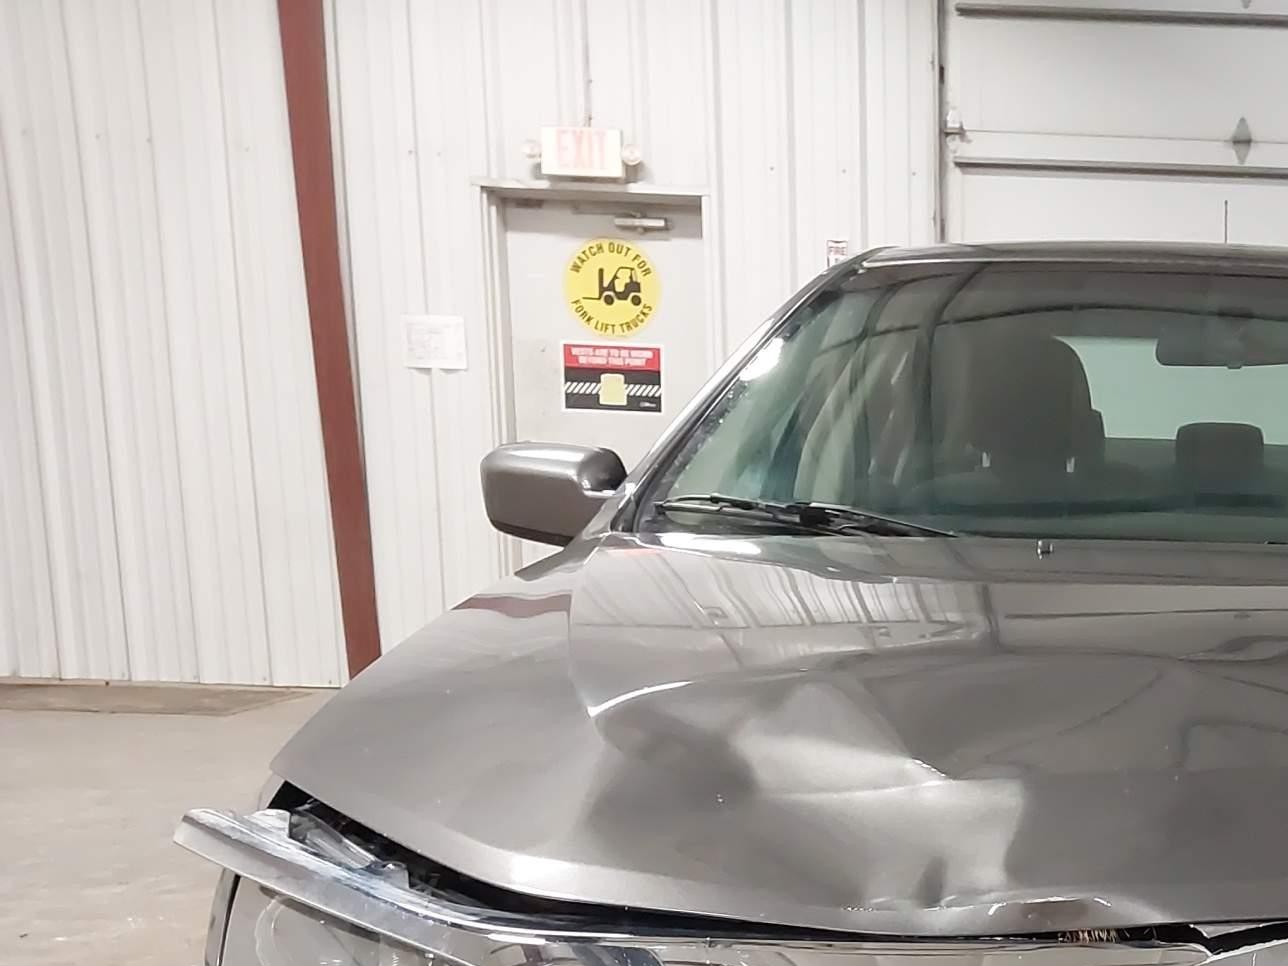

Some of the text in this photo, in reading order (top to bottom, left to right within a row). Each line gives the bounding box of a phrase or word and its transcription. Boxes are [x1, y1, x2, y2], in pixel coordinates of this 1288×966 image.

[556, 130, 607, 169] EXIT
[569, 242, 652, 277] WATCH OUT FOR
[570, 299, 653, 334] FORK LIFT TRUCKS
